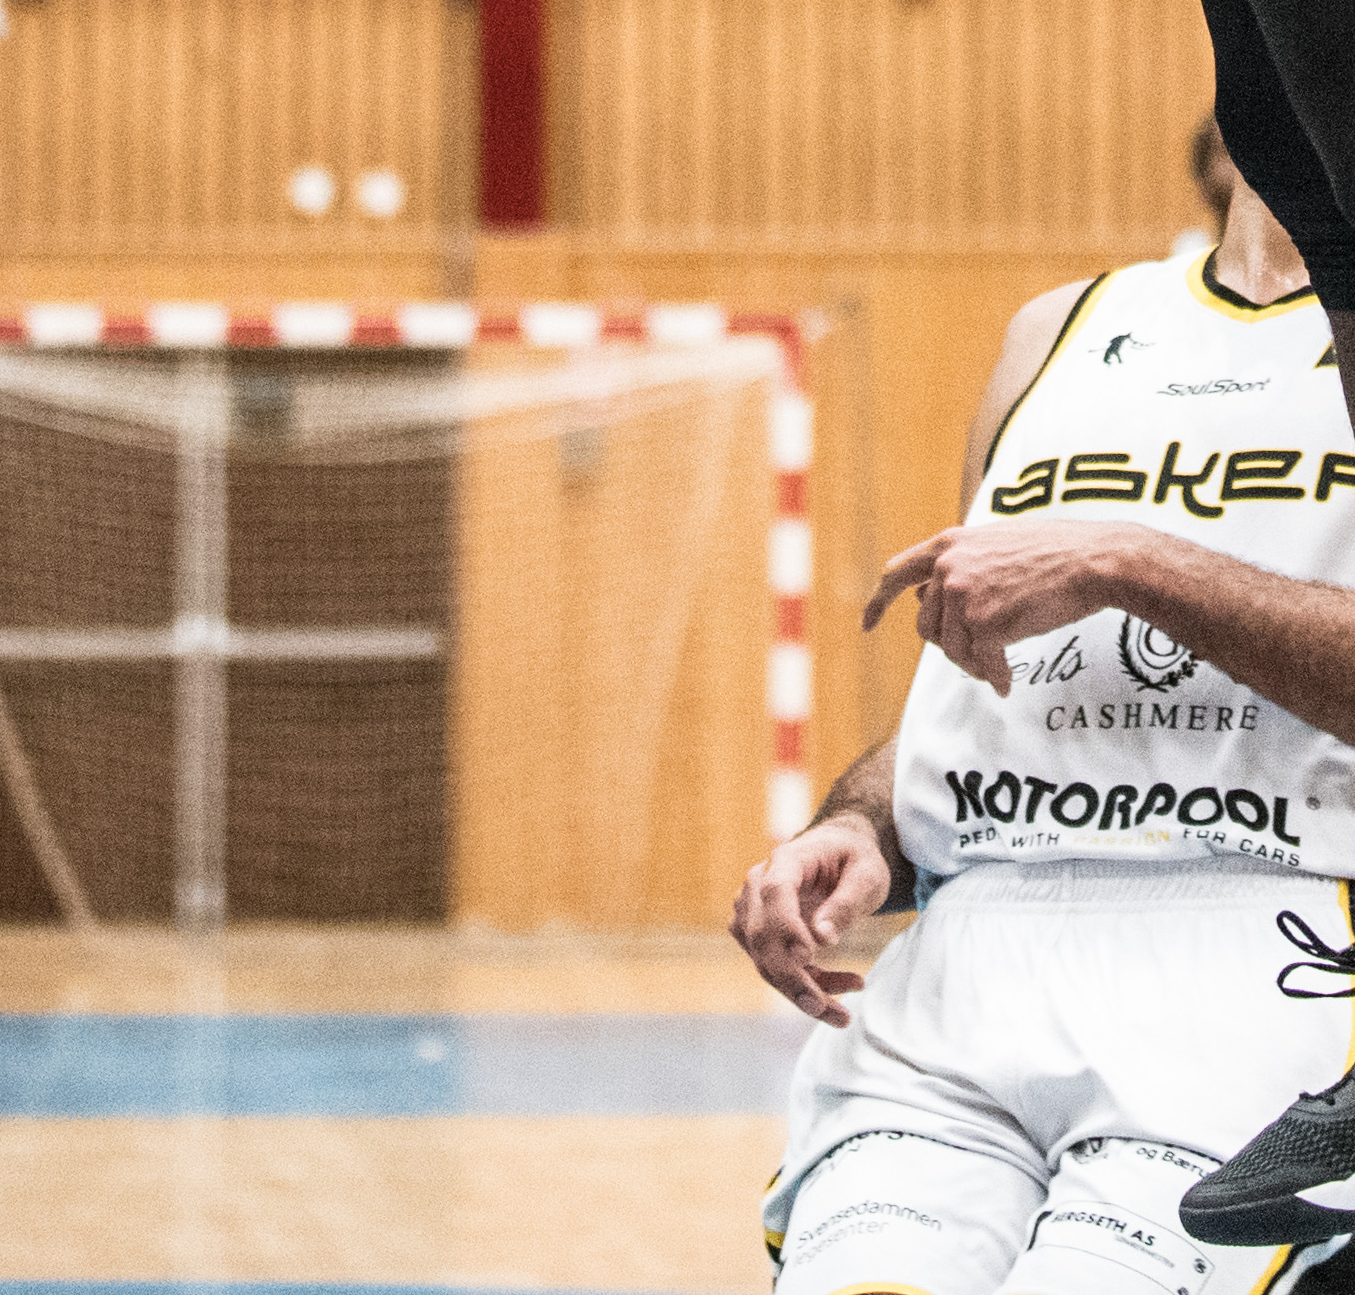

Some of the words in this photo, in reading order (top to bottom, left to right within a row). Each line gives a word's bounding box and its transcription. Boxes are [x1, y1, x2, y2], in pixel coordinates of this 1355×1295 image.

[1156, 378, 1271, 397] SoulSport
[1045, 702, 1261, 732] CASHMERE
[1012, 833, 1060, 848] WITH
[1183, 827, 1226, 844] FOR
[1238, 838, 1301, 867] CARS
[1135, 1147, 1158, 1160] og
[1130, 1229, 1156, 1246] AS
